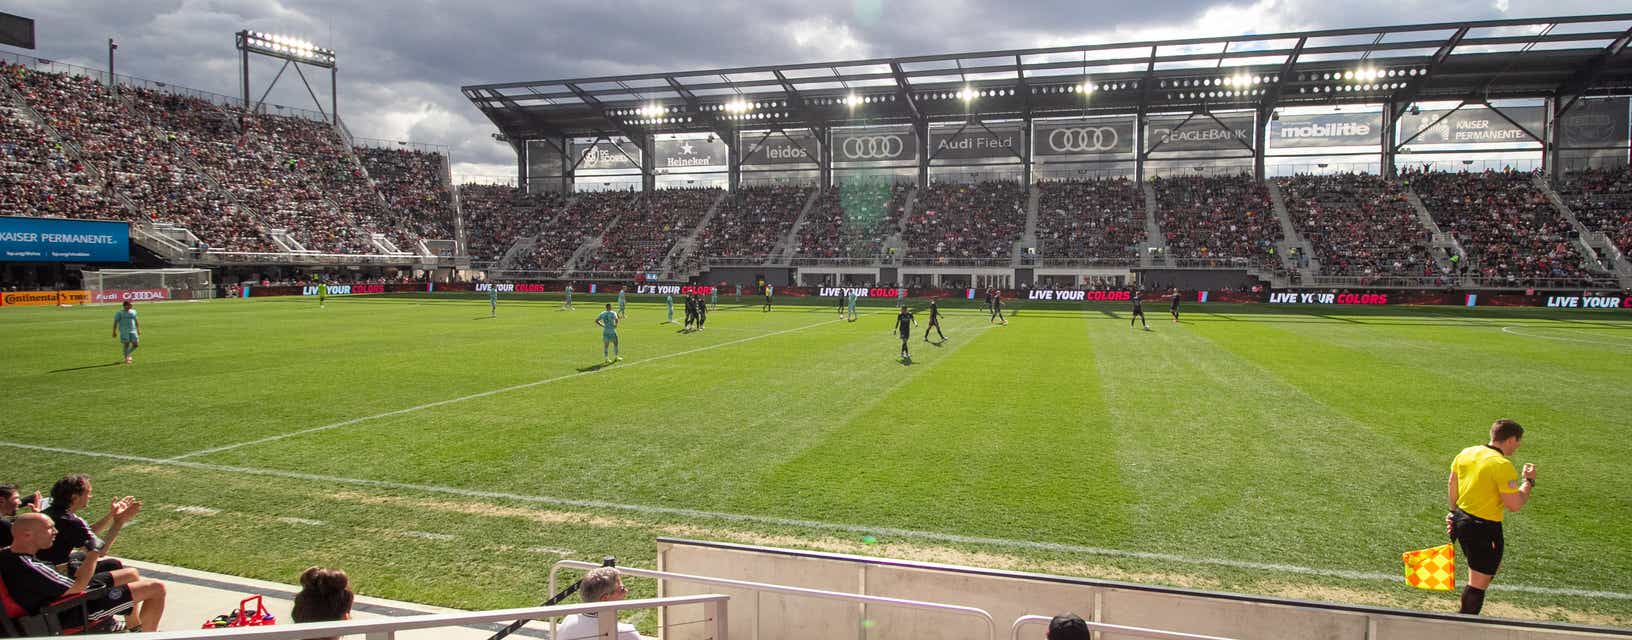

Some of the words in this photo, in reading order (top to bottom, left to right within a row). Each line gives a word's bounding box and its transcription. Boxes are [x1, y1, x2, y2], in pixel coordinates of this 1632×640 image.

[1281, 122, 1371, 138] mobilitie
[1456, 120, 1489, 129] KAISER
[1456, 129, 1522, 140] PERMANENTE
[937, 138, 973, 149] Audi
[976, 135, 1012, 148] Field
[766, 145, 808, 159] leidos
[667, 157, 709, 166] Heineken
[0, 232, 38, 242] KAISER
[41, 233, 113, 244] PERMANENTE
[303, 286, 320, 295] LIV
[326, 285, 351, 294] YOUR
[352, 285, 384, 293] COLORS
[475, 284, 493, 292] LIVE
[515, 284, 545, 292] COLORS
[657, 285, 680, 294] YOUR
[820, 287, 841, 296] LIVE
[1029, 290, 1053, 299] LIVE
[1056, 290, 1085, 300] YOUR
[1087, 291, 1130, 301] COLORS
[1269, 293, 1297, 303] LIVE
[1337, 294, 1387, 304] COLORS
[1547, 296, 1579, 307] LIVE
[1582, 297, 1620, 308] YOUR
